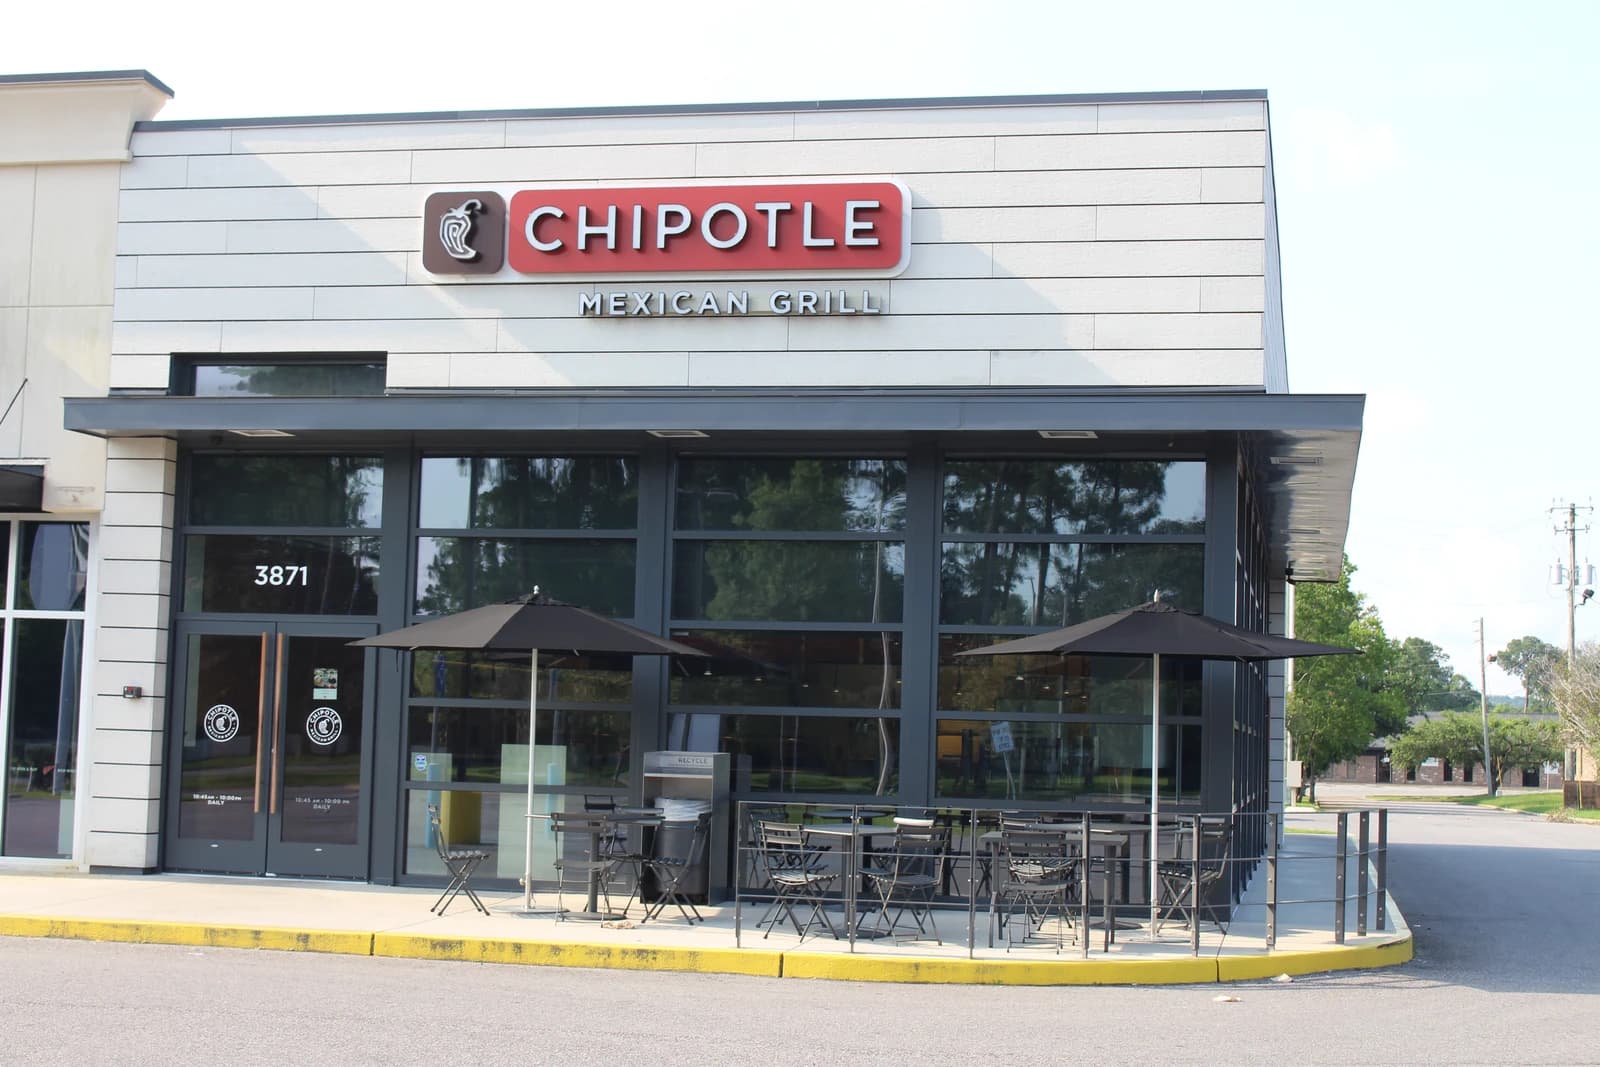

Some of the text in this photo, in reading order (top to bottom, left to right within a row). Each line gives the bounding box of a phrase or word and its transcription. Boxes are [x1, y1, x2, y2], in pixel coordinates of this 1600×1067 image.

[524, 199, 881, 252] CHIPOTLE
[578, 289, 881, 316] MEXICAN GRILL
[253, 565, 308, 586] 3871
[207, 707, 236, 722] CHIPOTLE
[310, 710, 339, 725] CHIPOTLE
